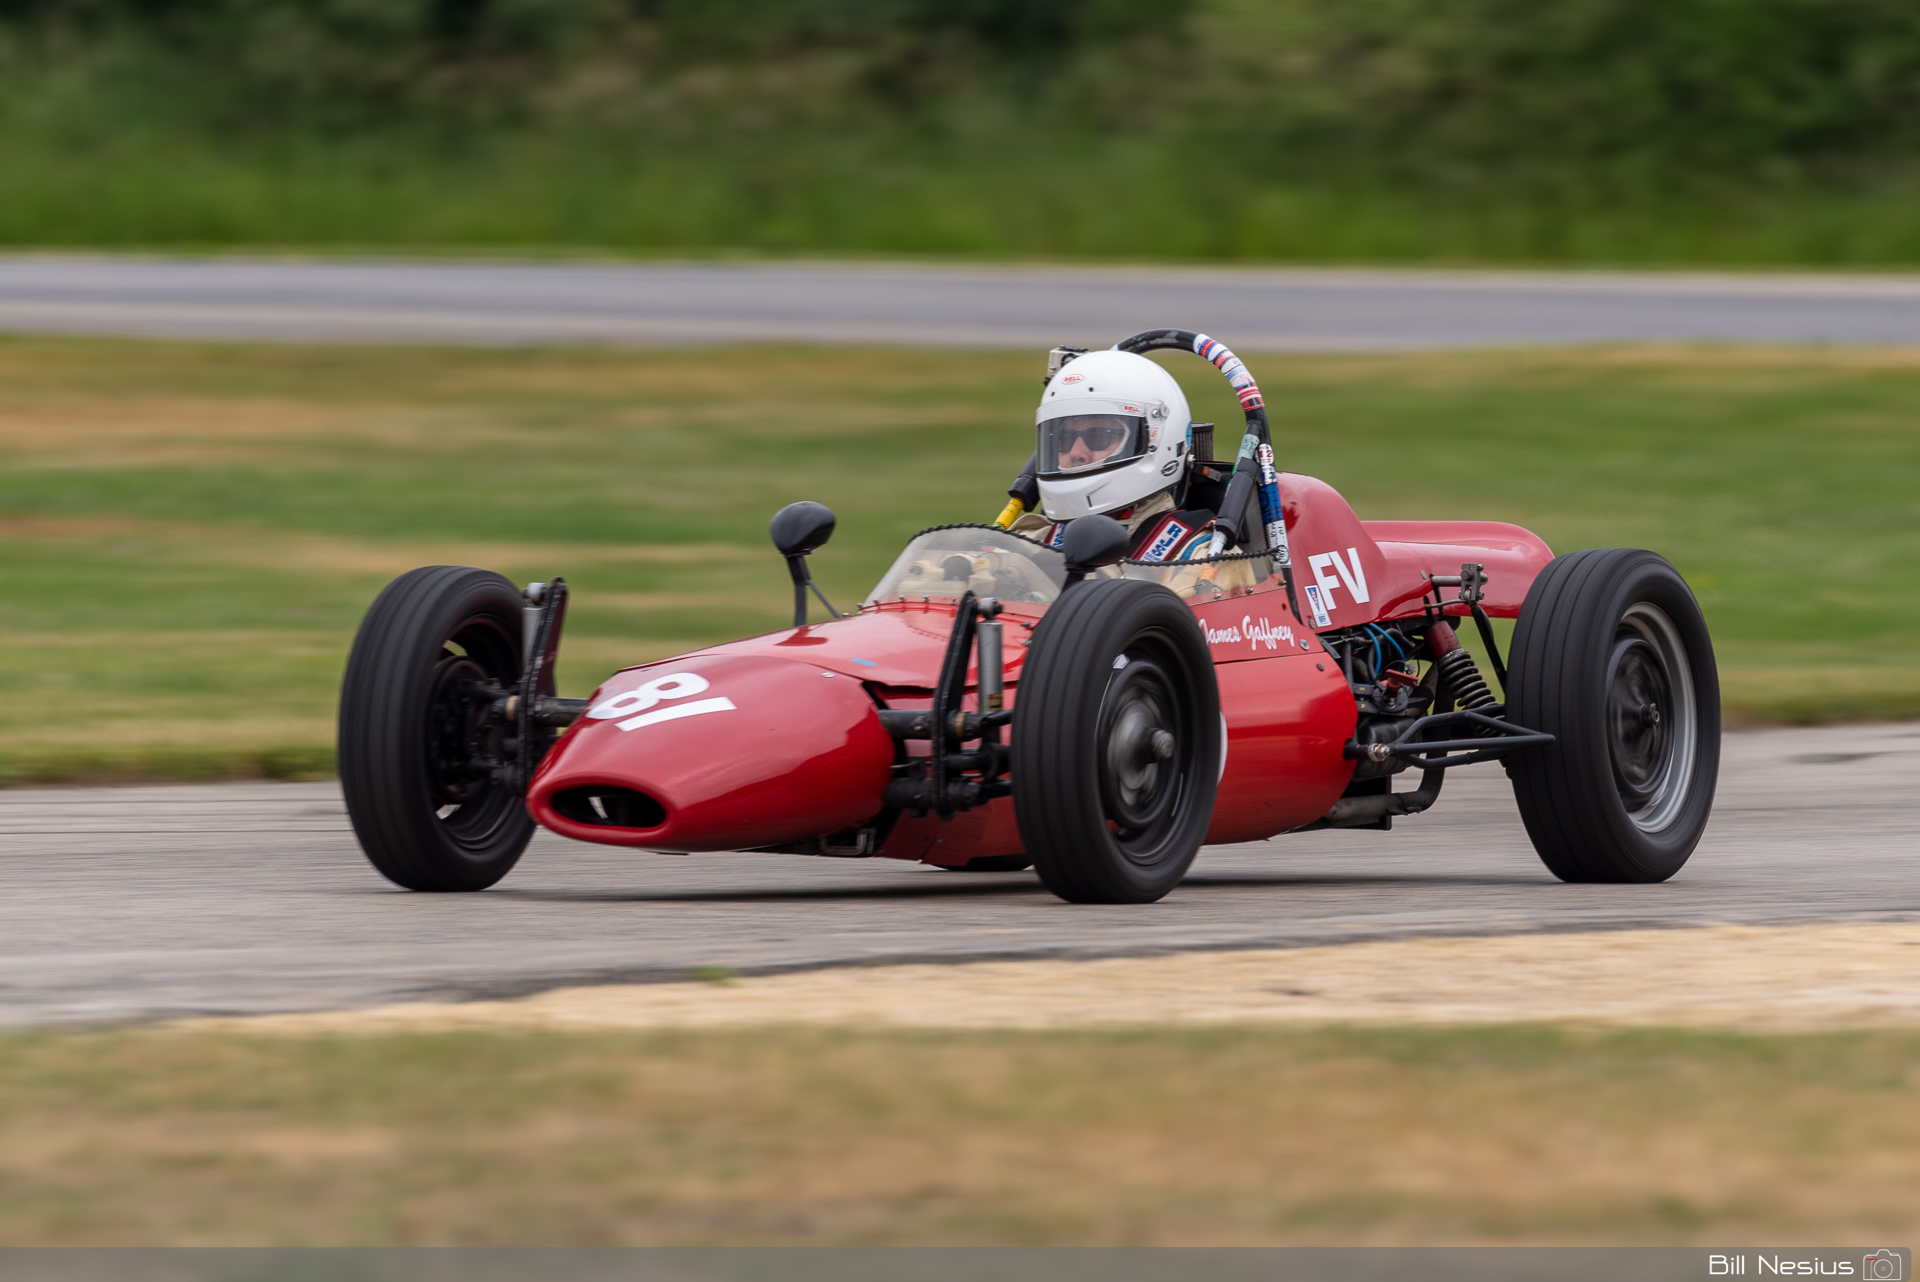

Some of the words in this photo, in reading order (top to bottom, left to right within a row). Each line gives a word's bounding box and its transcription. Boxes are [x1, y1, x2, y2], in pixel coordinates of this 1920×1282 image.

[1151, 523, 1183, 557] RJS
[1307, 547, 1370, 611] FV
[1198, 618, 1242, 646] James
[1242, 615, 1295, 651] Gaffney
[585, 672, 737, 732] 81
